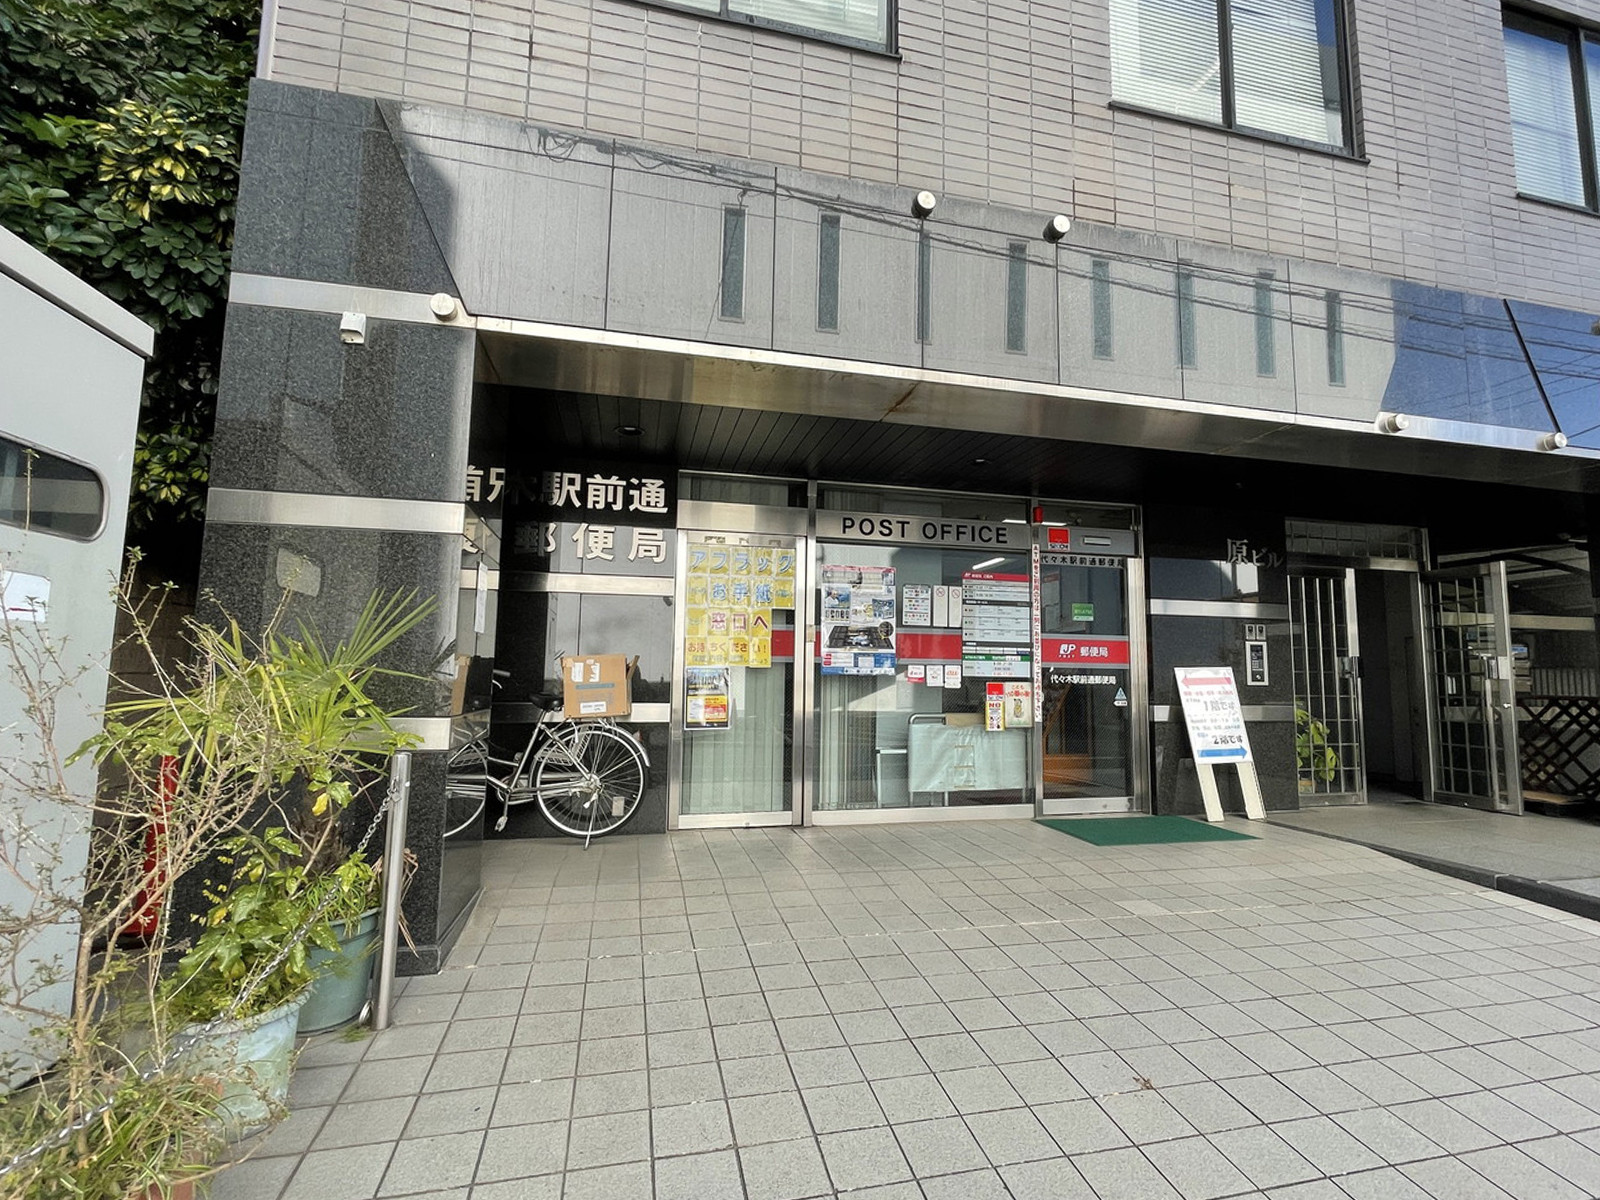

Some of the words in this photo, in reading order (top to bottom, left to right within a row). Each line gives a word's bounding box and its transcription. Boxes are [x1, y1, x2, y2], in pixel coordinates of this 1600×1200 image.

[842, 517, 910, 538] POST
[922, 522, 1008, 543] OFFICE
[691, 550, 793, 574] アフラック
[1226, 538, 1284, 568] 原ビル
[711, 613, 768, 630] 窓口へ
[1080, 646, 1108, 657] 郵便局
[1050, 674, 1117, 685] 代々木駅前通郵便局
